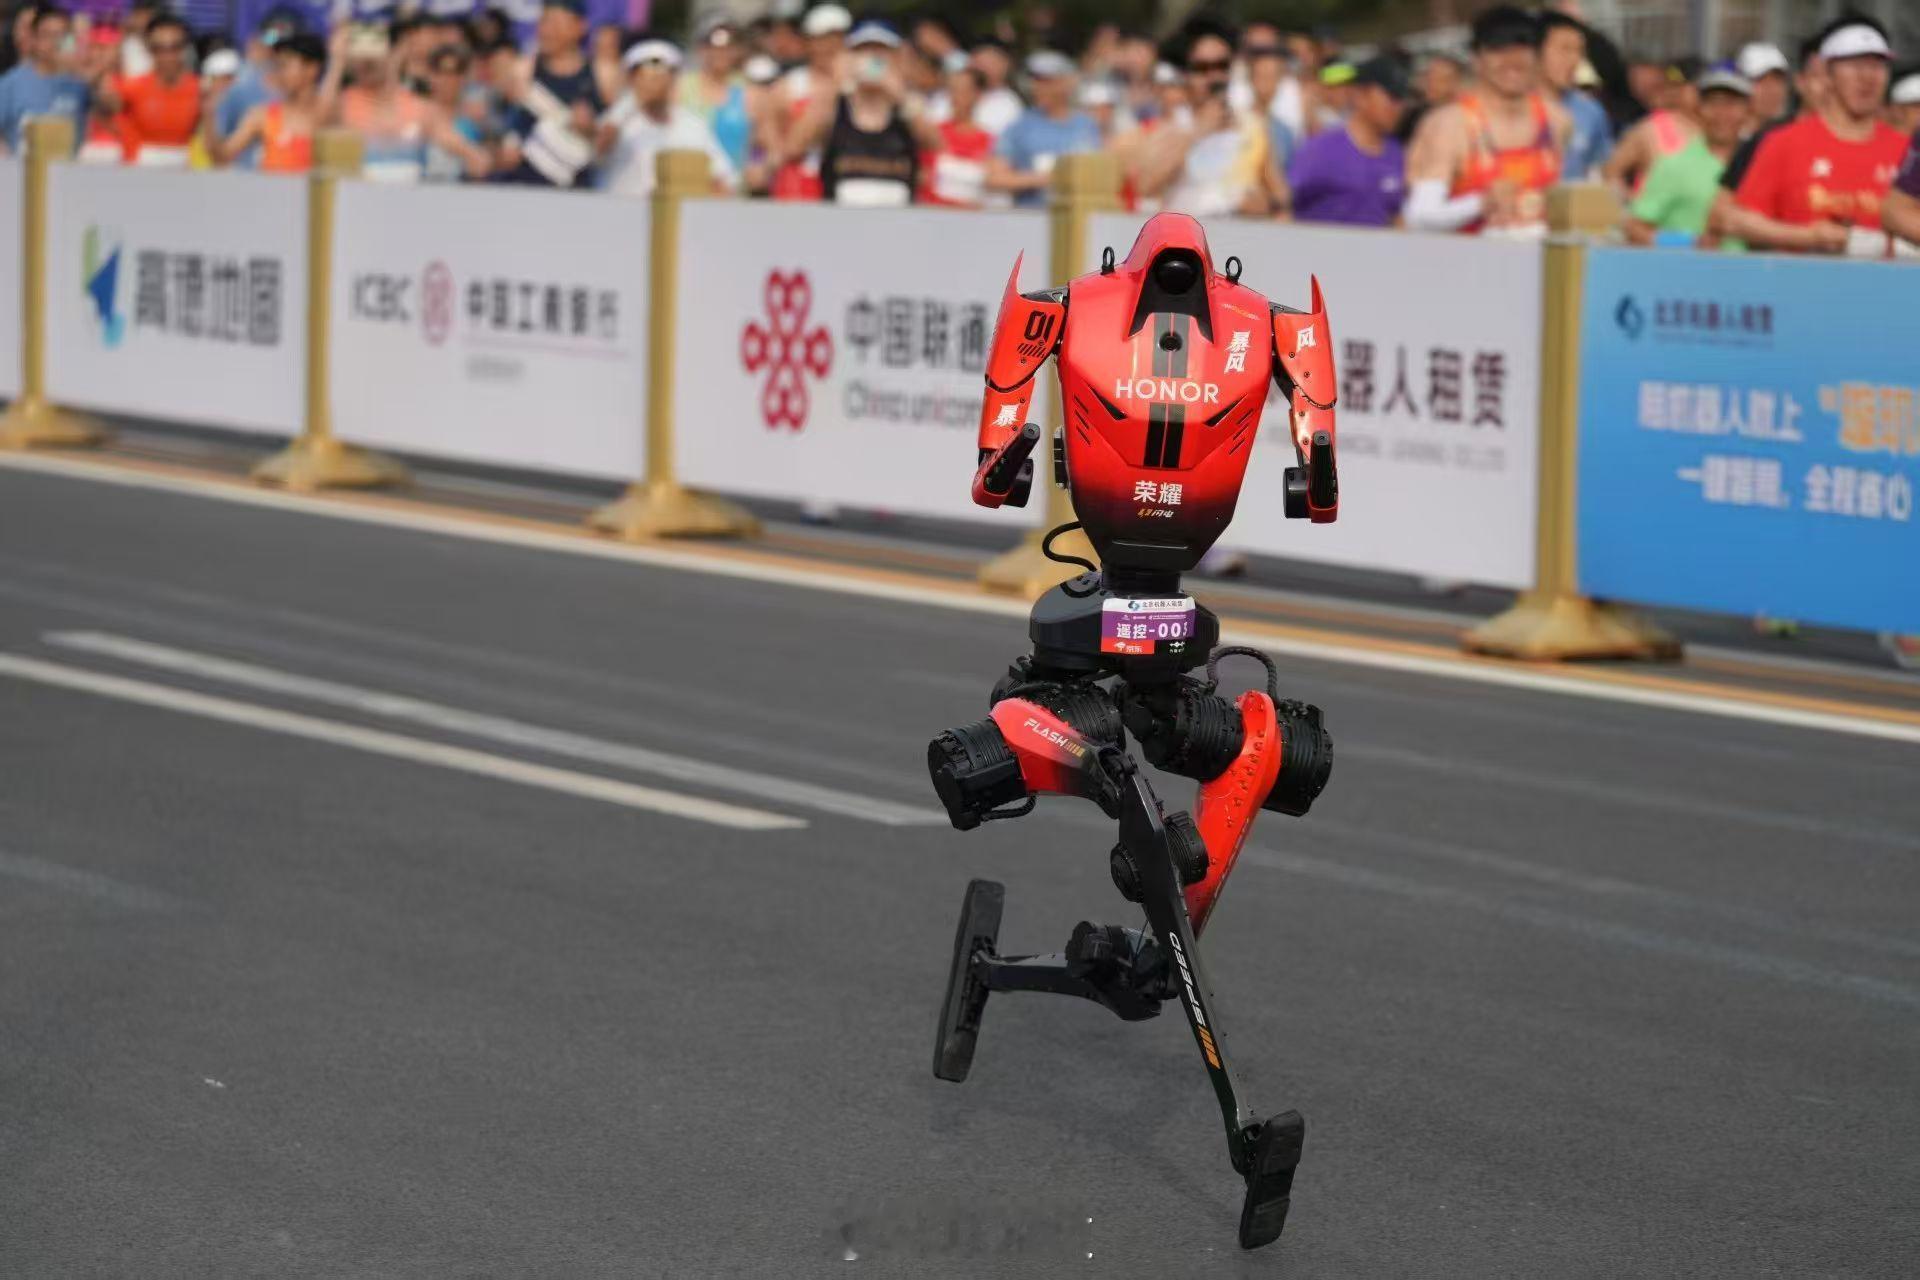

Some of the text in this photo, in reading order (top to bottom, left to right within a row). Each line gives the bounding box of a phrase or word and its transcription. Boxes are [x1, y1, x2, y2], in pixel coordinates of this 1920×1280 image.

[845, 296, 987, 372] 中国联通
[1024, 310, 1056, 342] 01
[1297, 324, 1317, 352] 风
[1224, 330, 1251, 373] 暴风
[1115, 378, 1219, 403] HONOR
[1268, 338, 1506, 428] 器人租赁
[992, 404, 1019, 427] 暴
[1133, 480, 1183, 505] 荣耀
[1023, 717, 1069, 747] FLASH
[1169, 931, 1206, 1027] SPEED
